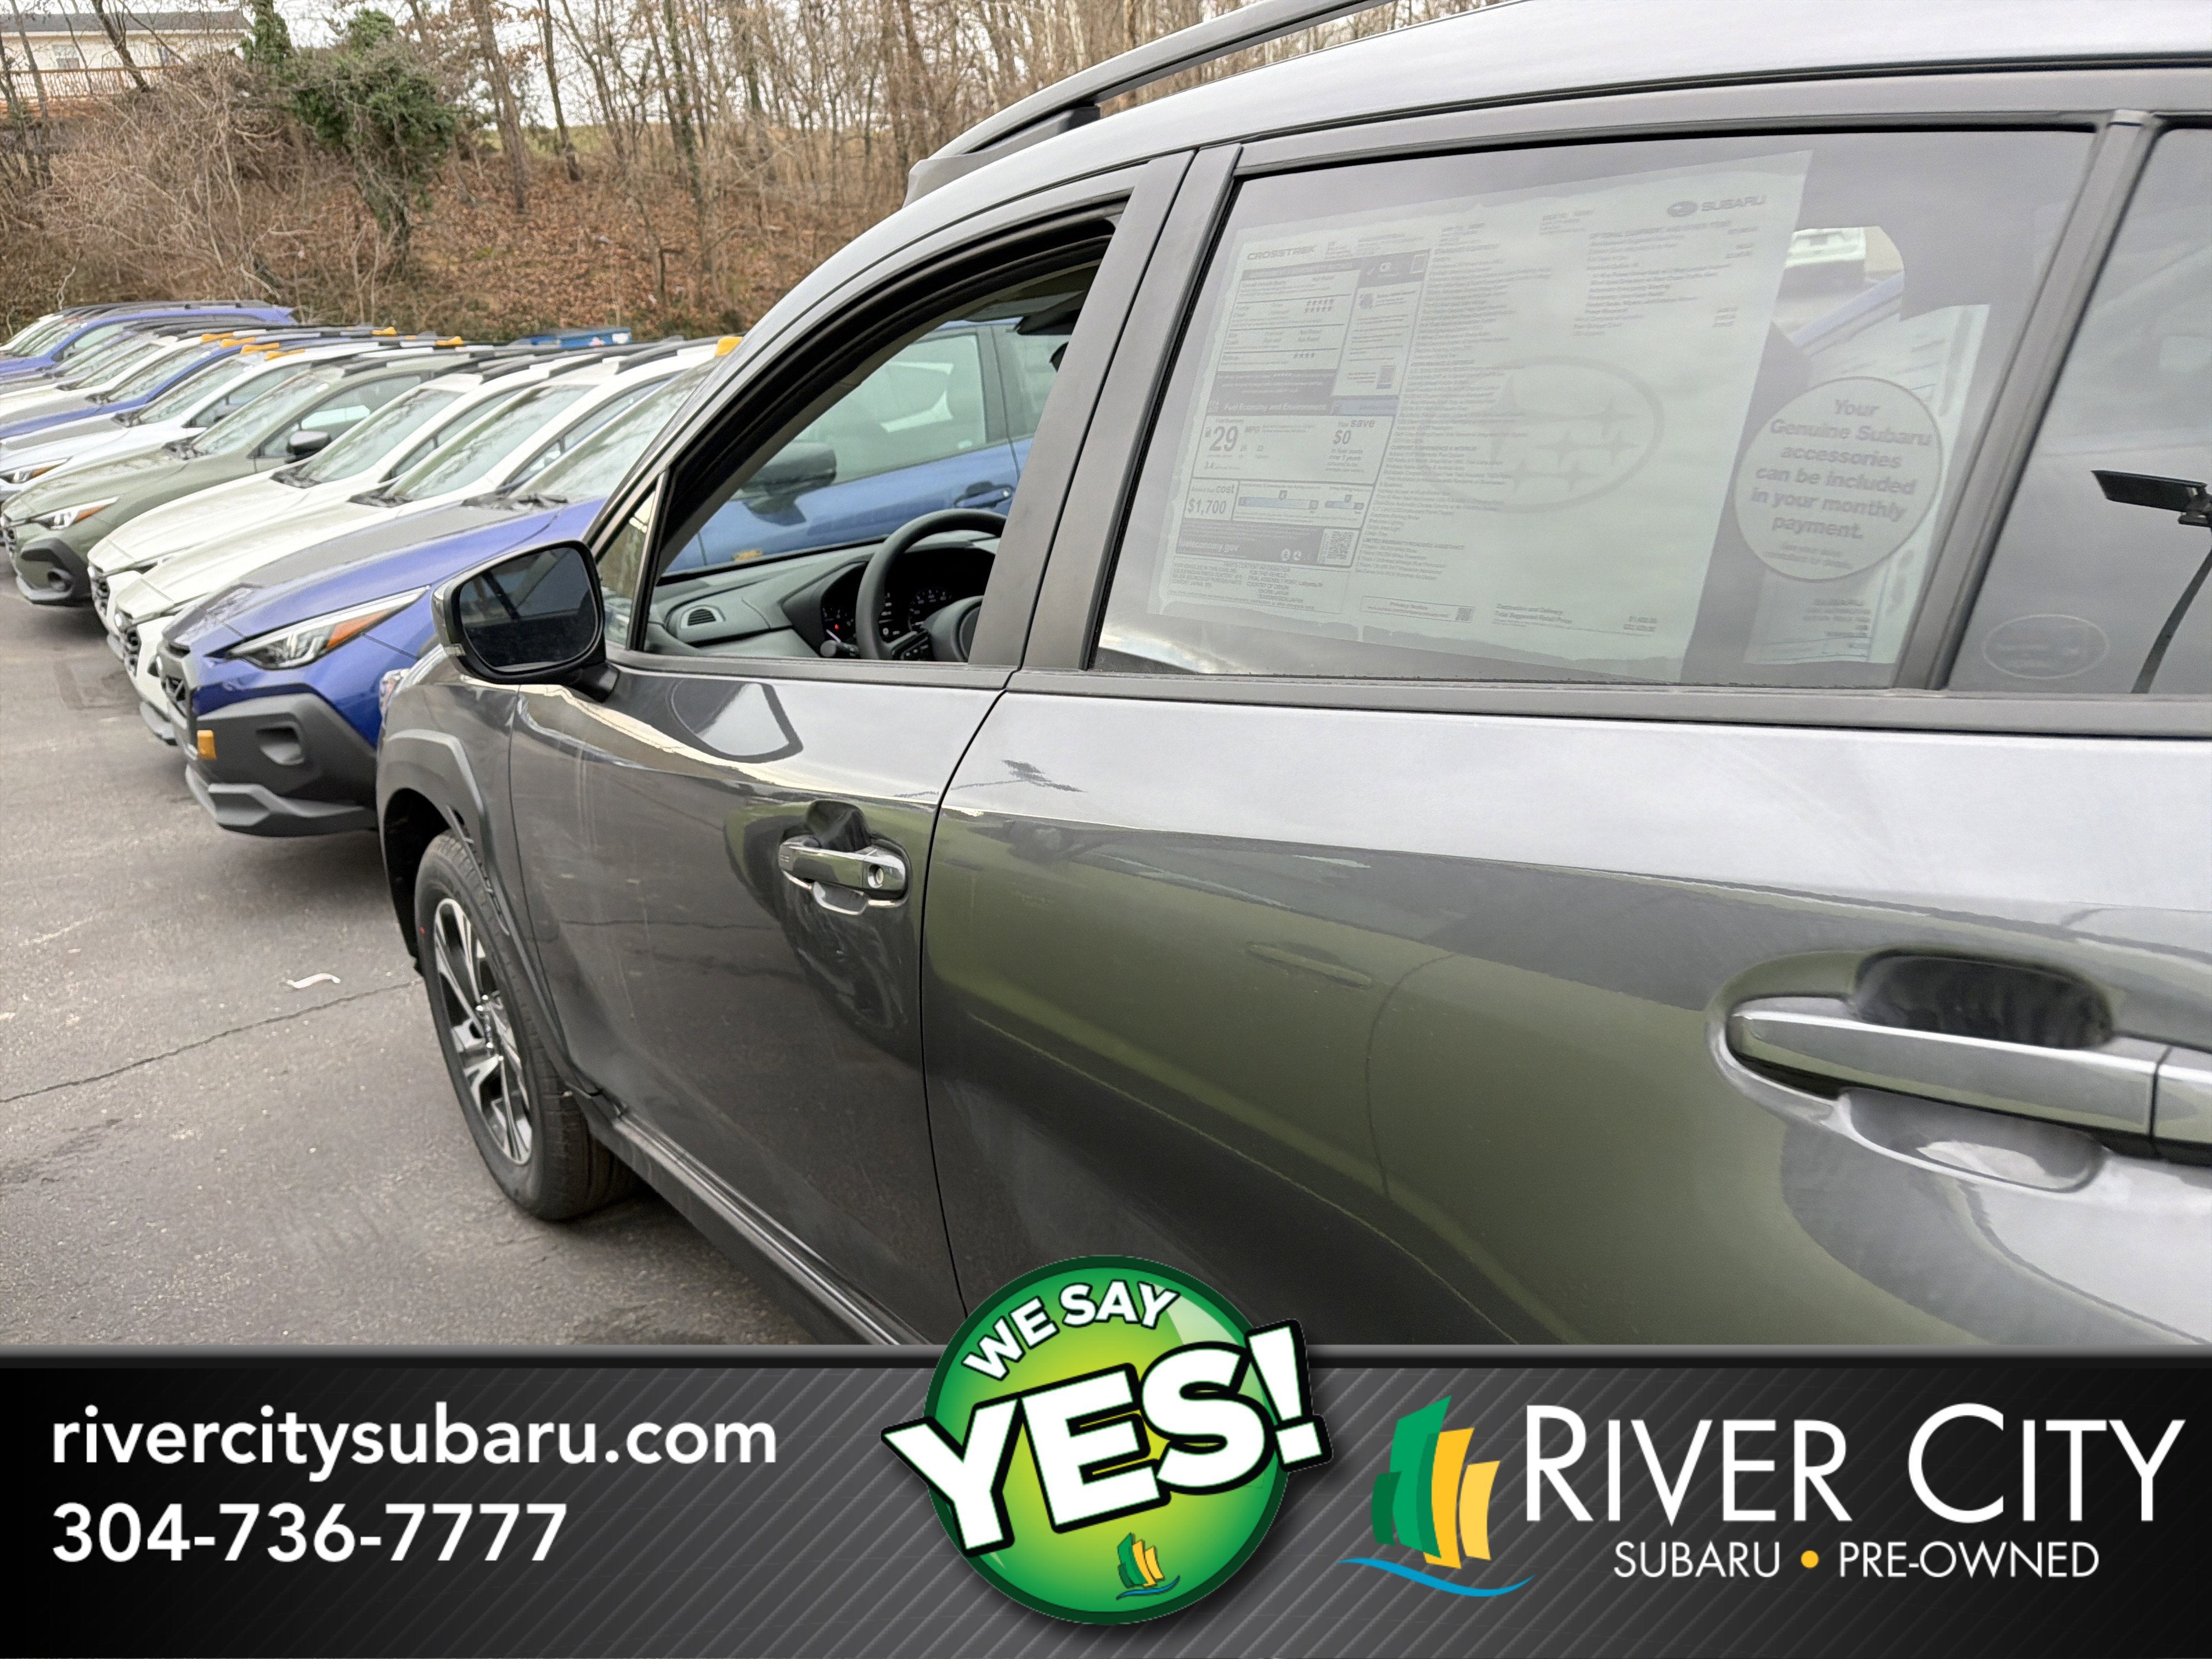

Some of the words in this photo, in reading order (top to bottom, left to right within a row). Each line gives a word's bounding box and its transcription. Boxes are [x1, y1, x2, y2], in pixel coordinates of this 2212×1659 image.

[1702, 195, 1767, 212] SUBARU
[1247, 245, 1317, 261] CROSSTREK
[1835, 399, 1879, 416] Your
[1350, 420, 1375, 428] save
[1770, 419, 1850, 439] Genuine
[1855, 425, 1932, 445] Subaru
[1209, 426, 1238, 452] 29
[1781, 447, 1903, 469] accessories
[1216, 484, 1234, 494] cost
[1756, 467, 1790, 482] can
[1796, 469, 1820, 484] be
[1825, 471, 1917, 495] included
[1187, 498, 1227, 516] $1,700
[1752, 487, 1769, 503] in
[1773, 492, 1819, 509] your
[1821, 498, 1908, 522] monthly
